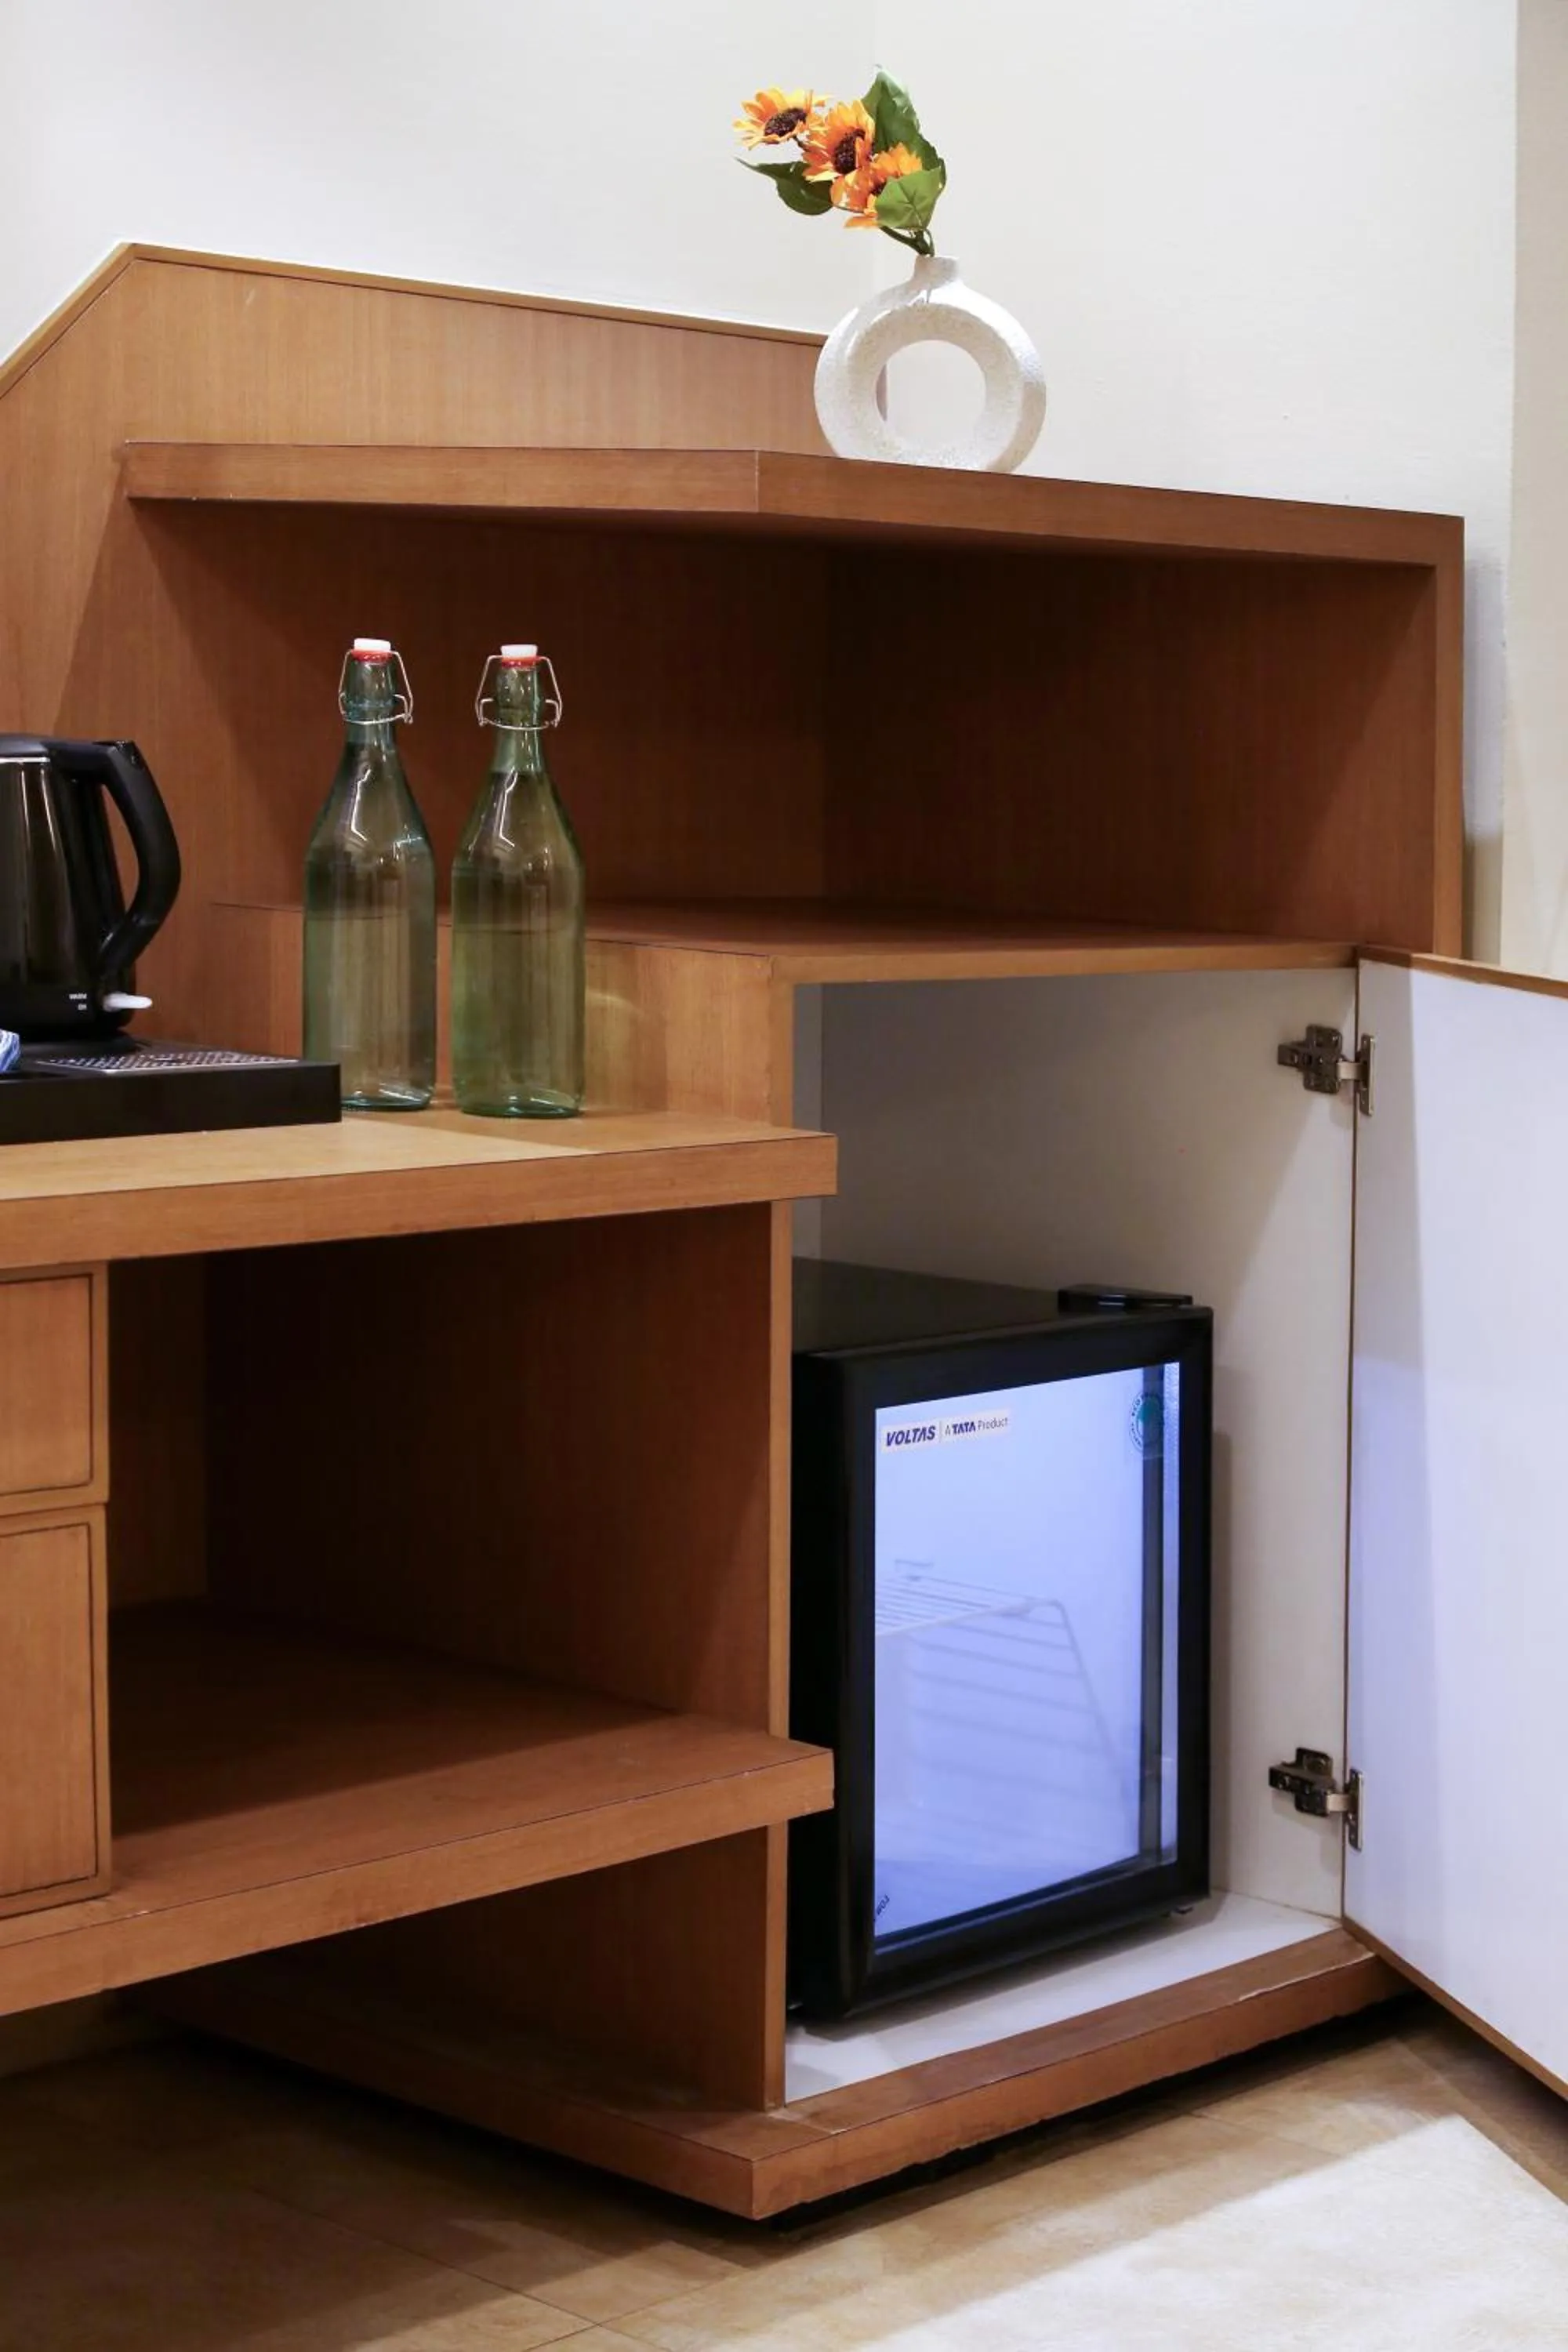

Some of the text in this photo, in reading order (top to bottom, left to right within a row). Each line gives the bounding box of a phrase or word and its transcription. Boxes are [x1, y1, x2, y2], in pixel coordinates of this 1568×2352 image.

[886, 1417, 1008, 1446] VOLTAS A TATA Product
